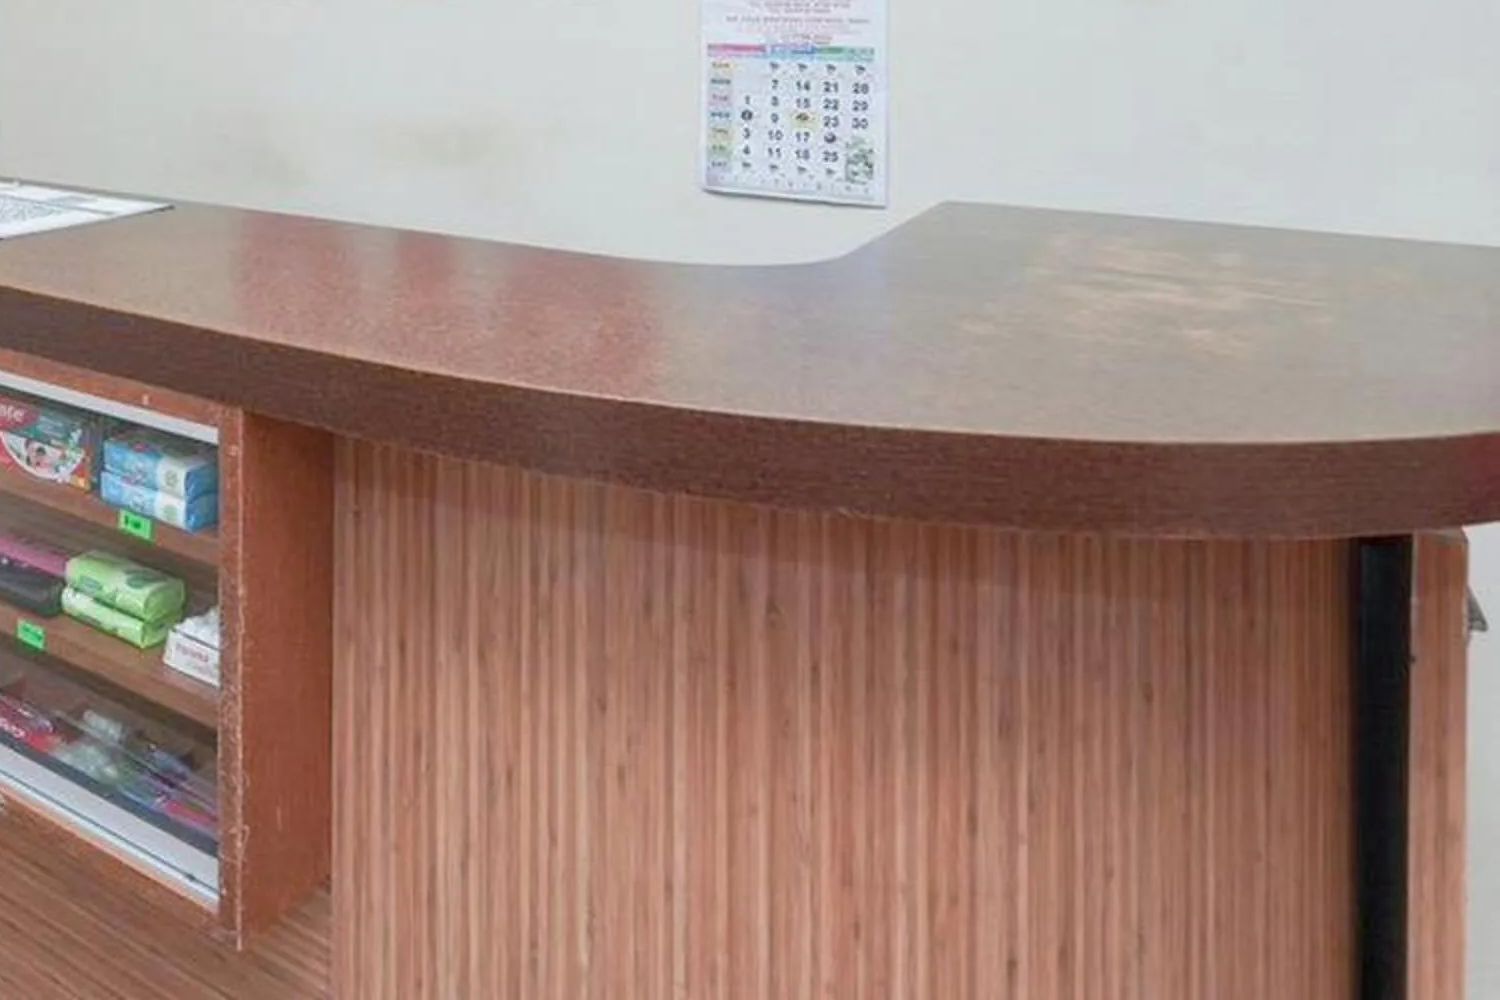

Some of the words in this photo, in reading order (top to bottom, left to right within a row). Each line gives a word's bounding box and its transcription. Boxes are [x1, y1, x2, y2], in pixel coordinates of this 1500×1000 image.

[795, 80, 812, 92] 14
[823, 81, 839, 93] 21
[852, 82, 870, 95] 28
[796, 98, 811, 109] 15
[823, 98, 840, 111] 22
[852, 100, 869, 112] 29
[770, 112, 779, 124] 9
[823, 115, 840, 128] 23
[851, 117, 869, 130] 30
[767, 129, 784, 141] 10
[795, 131, 811, 142] 17
[767, 147, 782, 159] 11
[822, 150, 839, 162] 25
